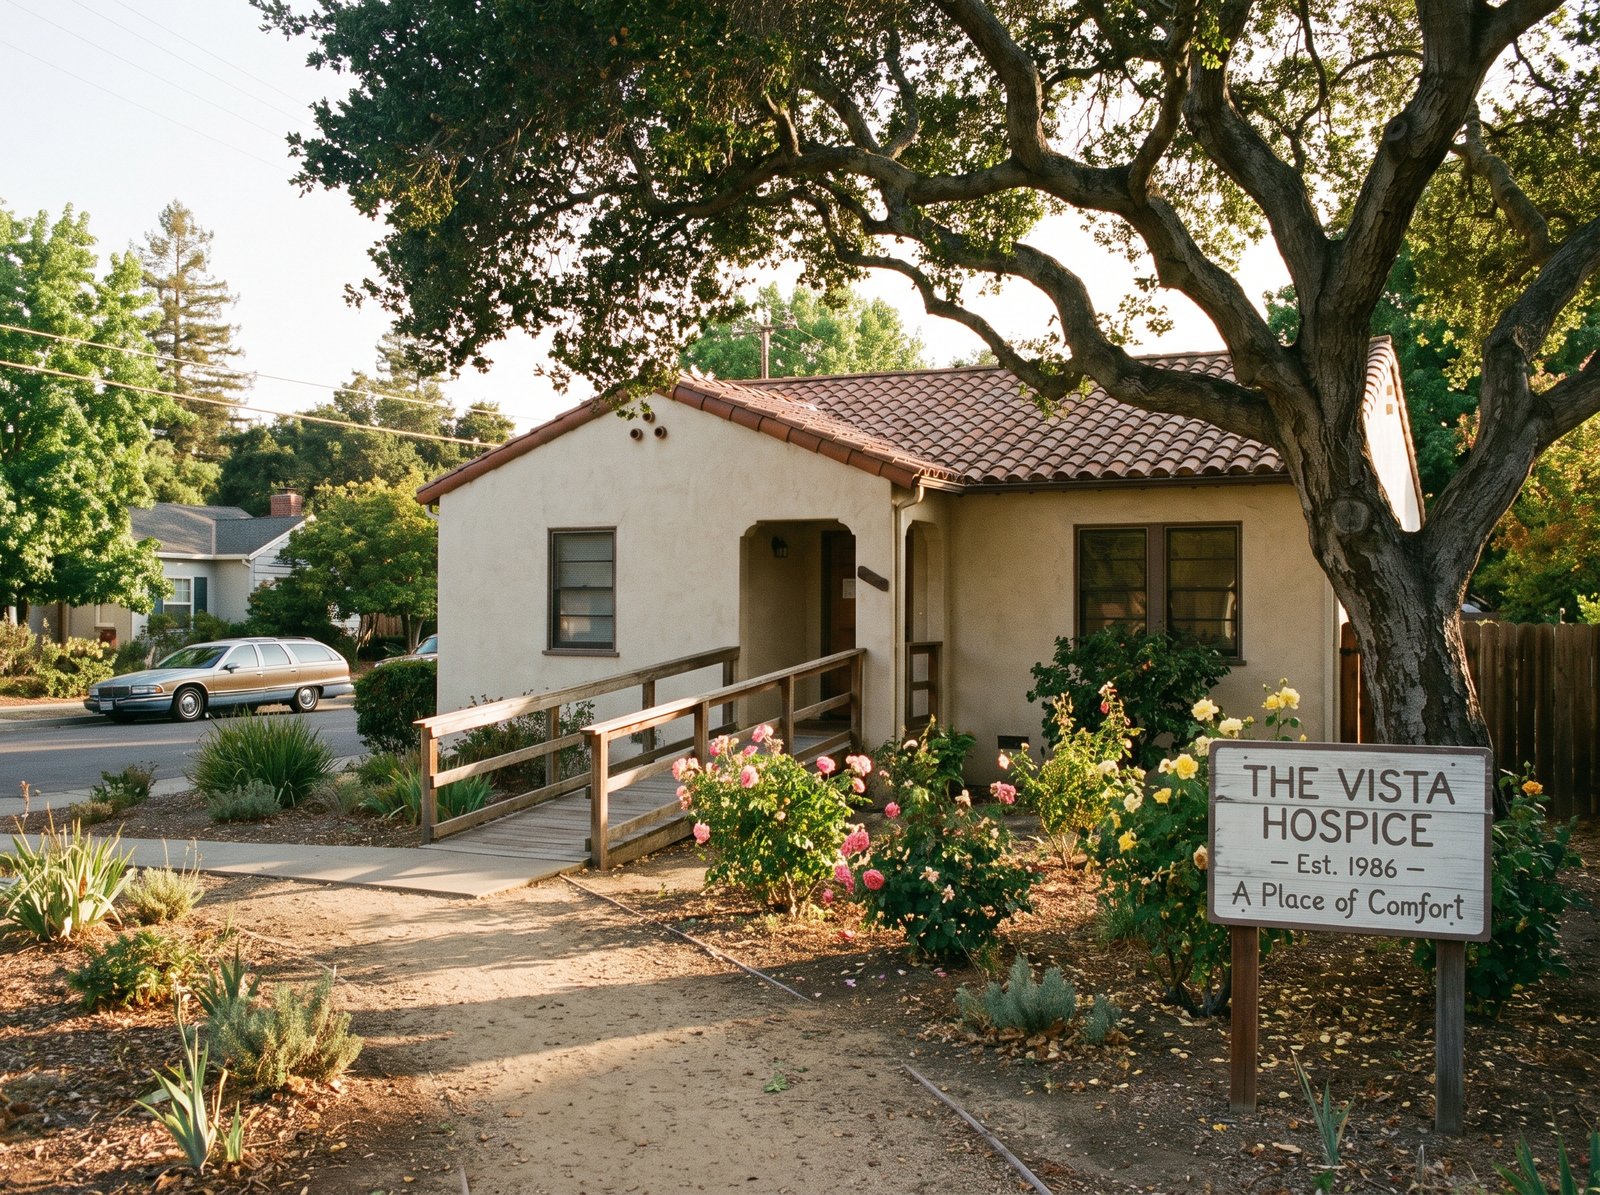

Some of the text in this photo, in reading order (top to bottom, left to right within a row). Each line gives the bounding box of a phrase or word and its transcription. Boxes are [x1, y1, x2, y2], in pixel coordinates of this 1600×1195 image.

[1243, 764, 1455, 805] THE VISTA
[1263, 806, 1434, 848] HOSPICE
[1297, 853, 1398, 878] Est. 1986
[1232, 880, 1465, 924] A Place of Comfort
